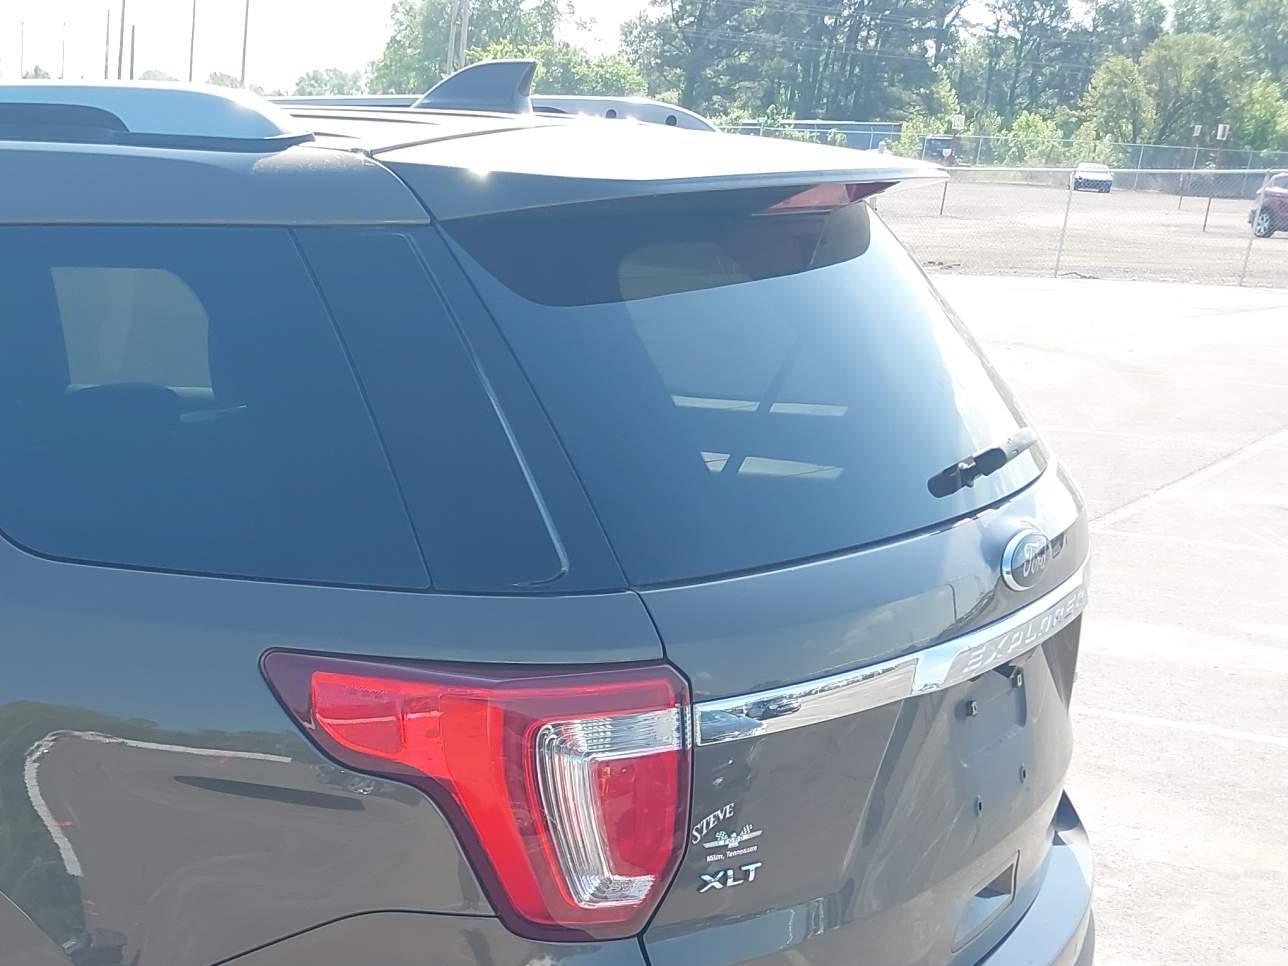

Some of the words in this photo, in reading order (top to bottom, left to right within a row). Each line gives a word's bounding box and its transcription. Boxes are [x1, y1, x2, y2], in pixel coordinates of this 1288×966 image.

[1023, 542, 1047, 577] Ford
[962, 590, 1085, 675] EXPLORER
[691, 802, 735, 844] STEVE
[698, 862, 763, 893] XLT
